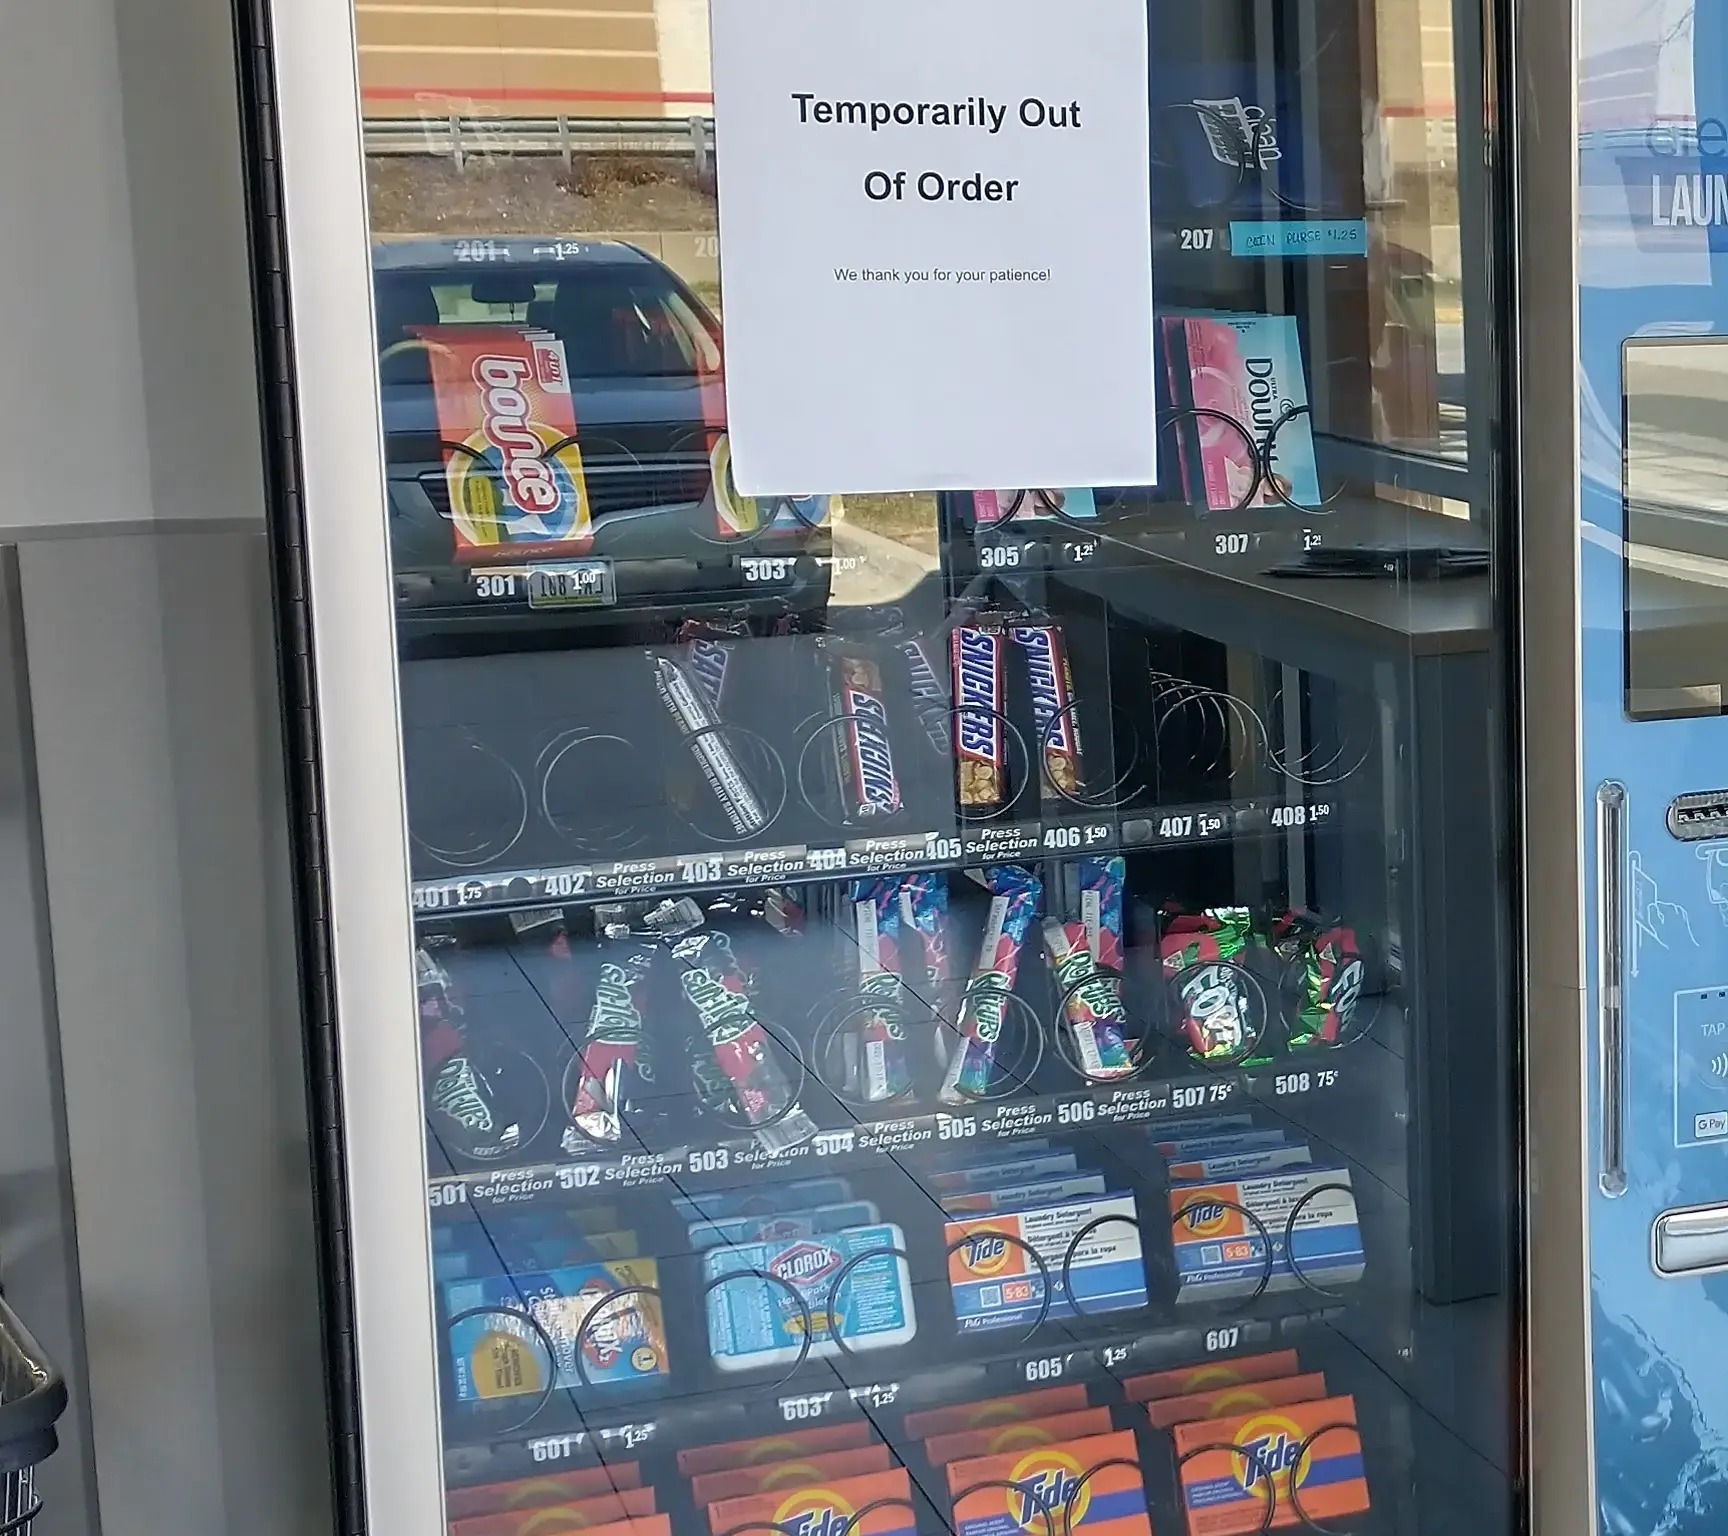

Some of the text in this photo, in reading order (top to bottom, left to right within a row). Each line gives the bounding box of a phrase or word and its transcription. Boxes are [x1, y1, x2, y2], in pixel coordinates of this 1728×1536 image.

[791, 93, 1082, 133] Temporarily Out
[863, 170, 1020, 202] Of Order
[1180, 229, 1214, 250] 207
[1246, 228, 1358, 249] COIN PURSE $1.25
[455, 240, 580, 262] 201 1.25
[833, 268, 1052, 285] We thank you for your patience!
[475, 354, 558, 510] bounce
[1215, 534, 1249, 554] 307
[981, 547, 1019, 568] 305
[745, 557, 856, 581] 303 1.00
[476, 574, 515, 597] 301
[572, 571, 596, 591] 1.00
[961, 628, 996, 761] SNICKERS
[1271, 804, 1330, 827] 408 1.50
[981, 827, 1021, 840] Press
[1159, 816, 1221, 837] 407 1.50
[865, 838, 907, 852] Press
[965, 836, 1038, 854] Selection
[1043, 826, 1107, 849] 406 1.50
[743, 850, 786, 863] Press
[807, 849, 847, 870] 404
[849, 848, 925, 865] Selection
[926, 838, 962, 860] 405
[981, 850, 1021, 861] for Price
[613, 861, 656, 875] Press
[682, 861, 722, 883] 403
[727, 859, 804, 877] Selection
[866, 861, 907, 872] for Price
[544, 873, 585, 895] 402
[595, 870, 675, 889] Selection
[745, 873, 786, 883] for Price
[412, 885, 482, 909] 401 1.75
[614, 884, 657, 896] for Price
[1701, 1022, 1726, 1037] TAP
[1275, 1070, 1339, 1095] 508 75¢
[1112, 1087, 1150, 1102] Press
[1172, 1083, 1232, 1109] 507 75¢
[997, 1103, 1036, 1117] Press
[1057, 1100, 1095, 1124] 506
[1097, 1097, 1166, 1117] Selection
[1112, 1110, 1150, 1122] for Price
[874, 1120, 915, 1134] Press
[938, 1116, 977, 1140] 505
[981, 1112, 1052, 1132] Selection
[997, 1125, 1036, 1137] for Price
[1698, 1118, 1726, 1130] G Pay
[858, 1130, 931, 1148] Selection
[875, 1142, 915, 1153] for Price
[622, 1153, 664, 1166] Press
[689, 1149, 728, 1172] 503
[490, 1169, 534, 1183] Press
[559, 1165, 601, 1189] 502
[604, 1162, 682, 1180] Selection
[622, 1176, 664, 1187] for Price
[429, 1183, 466, 1207] 501
[473, 1178, 553, 1198] Selection
[1242, 1180, 1271, 1191] Laundry
[491, 1192, 534, 1204] for Price
[1024, 1214, 1054, 1224] Laundry
[1187, 1203, 1224, 1228] Tide
[777, 1246, 835, 1280] CLOROX
[963, 1237, 1005, 1268] Tide
[1207, 1328, 1239, 1353] 607
[1026, 1346, 1128, 1381] 605 1.25
[783, 1392, 895, 1419] 603 1.25
[531, 1430, 648, 1461] 601 1.25
[1236, 1432, 1302, 1491] Tide
[1013, 1467, 1081, 1528] Tide
